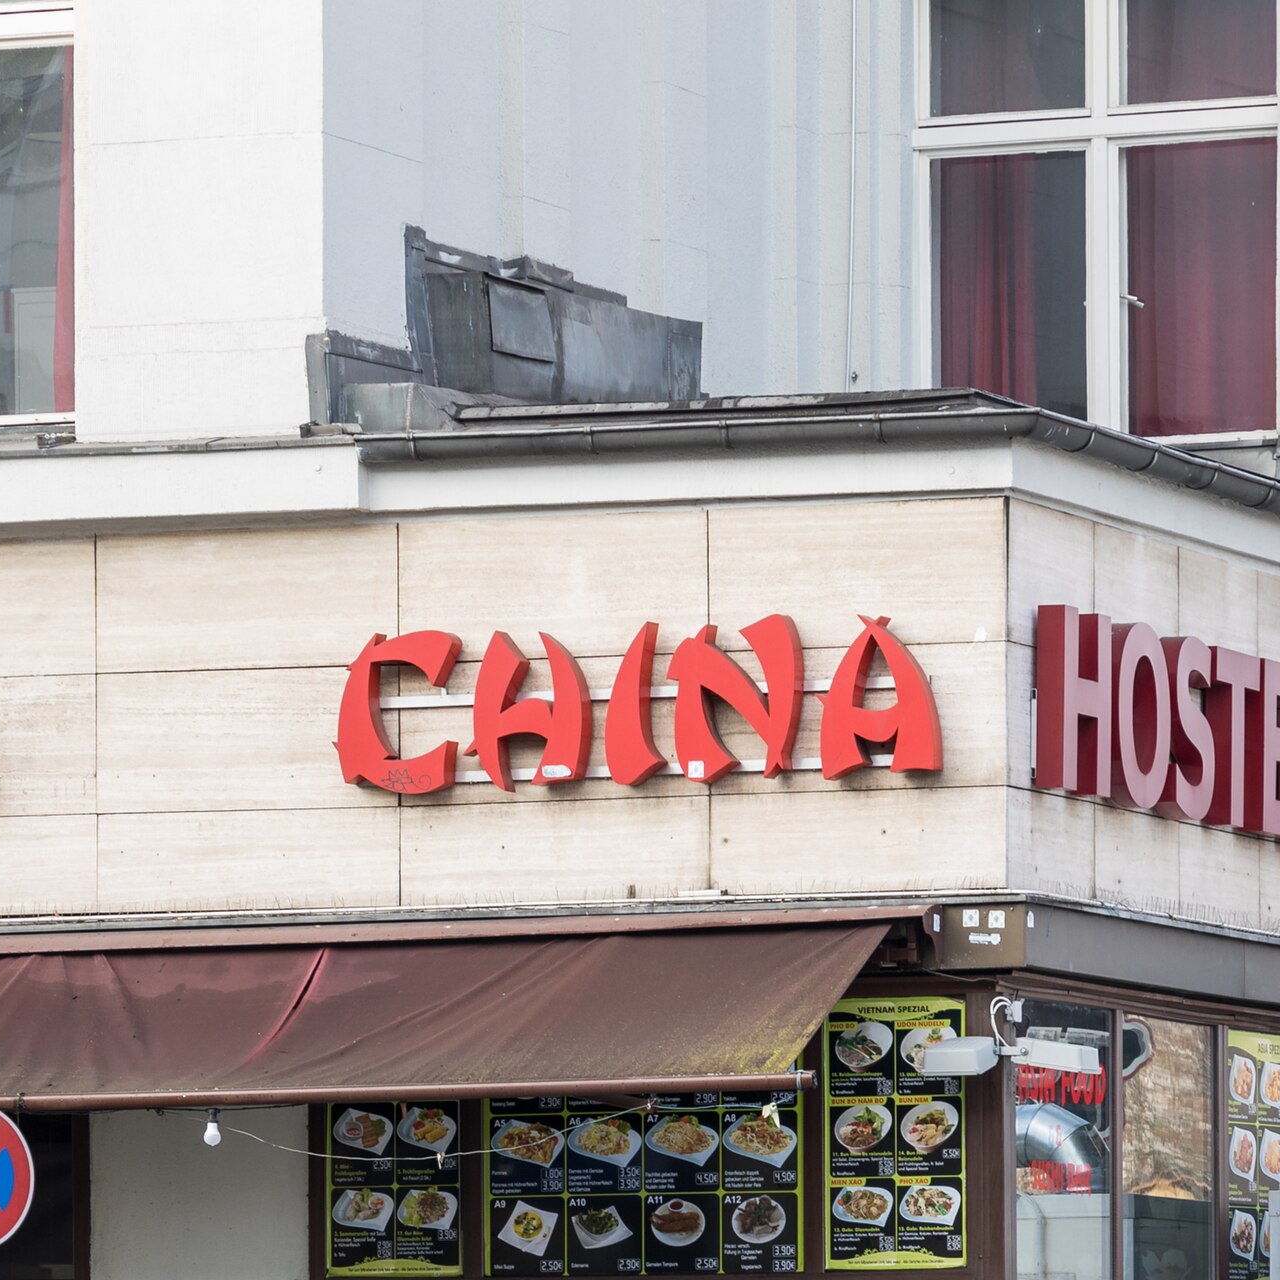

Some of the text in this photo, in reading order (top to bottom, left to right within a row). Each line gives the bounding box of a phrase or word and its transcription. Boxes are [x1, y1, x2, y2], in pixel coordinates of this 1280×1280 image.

[332, 614, 942, 794] CHINA
[857, 1005, 930, 1014] VIETNAM SPEZIAL
[1018, 1062, 1106, 1106] ASIA FOOD
[569, 1117, 581, 1125] A6
[647, 1114, 659, 1122] A7
[724, 1114, 736, 1122] A8
[494, 1119, 506, 1128] A5
[620, 1167, 640, 1177] 3.50€
[775, 1171, 795, 1181] 4.90€
[696, 1173, 718, 1183] 4.50€
[543, 1180, 563, 1190] 3.90€
[620, 1178, 640, 1189] 3.90€
[494, 1200, 506, 1208] A9
[569, 1198, 586, 1207] A10
[647, 1195, 663, 1204] A11
[724, 1195, 741, 1204] A12
[774, 1245, 795, 1256] 3.90€
[542, 1261, 562, 1271] 2.50€
[619, 1260, 640, 1271] 2.90€
[697, 1259, 718, 1269] 2.50€
[774, 1261, 795, 1271] 3.90€
